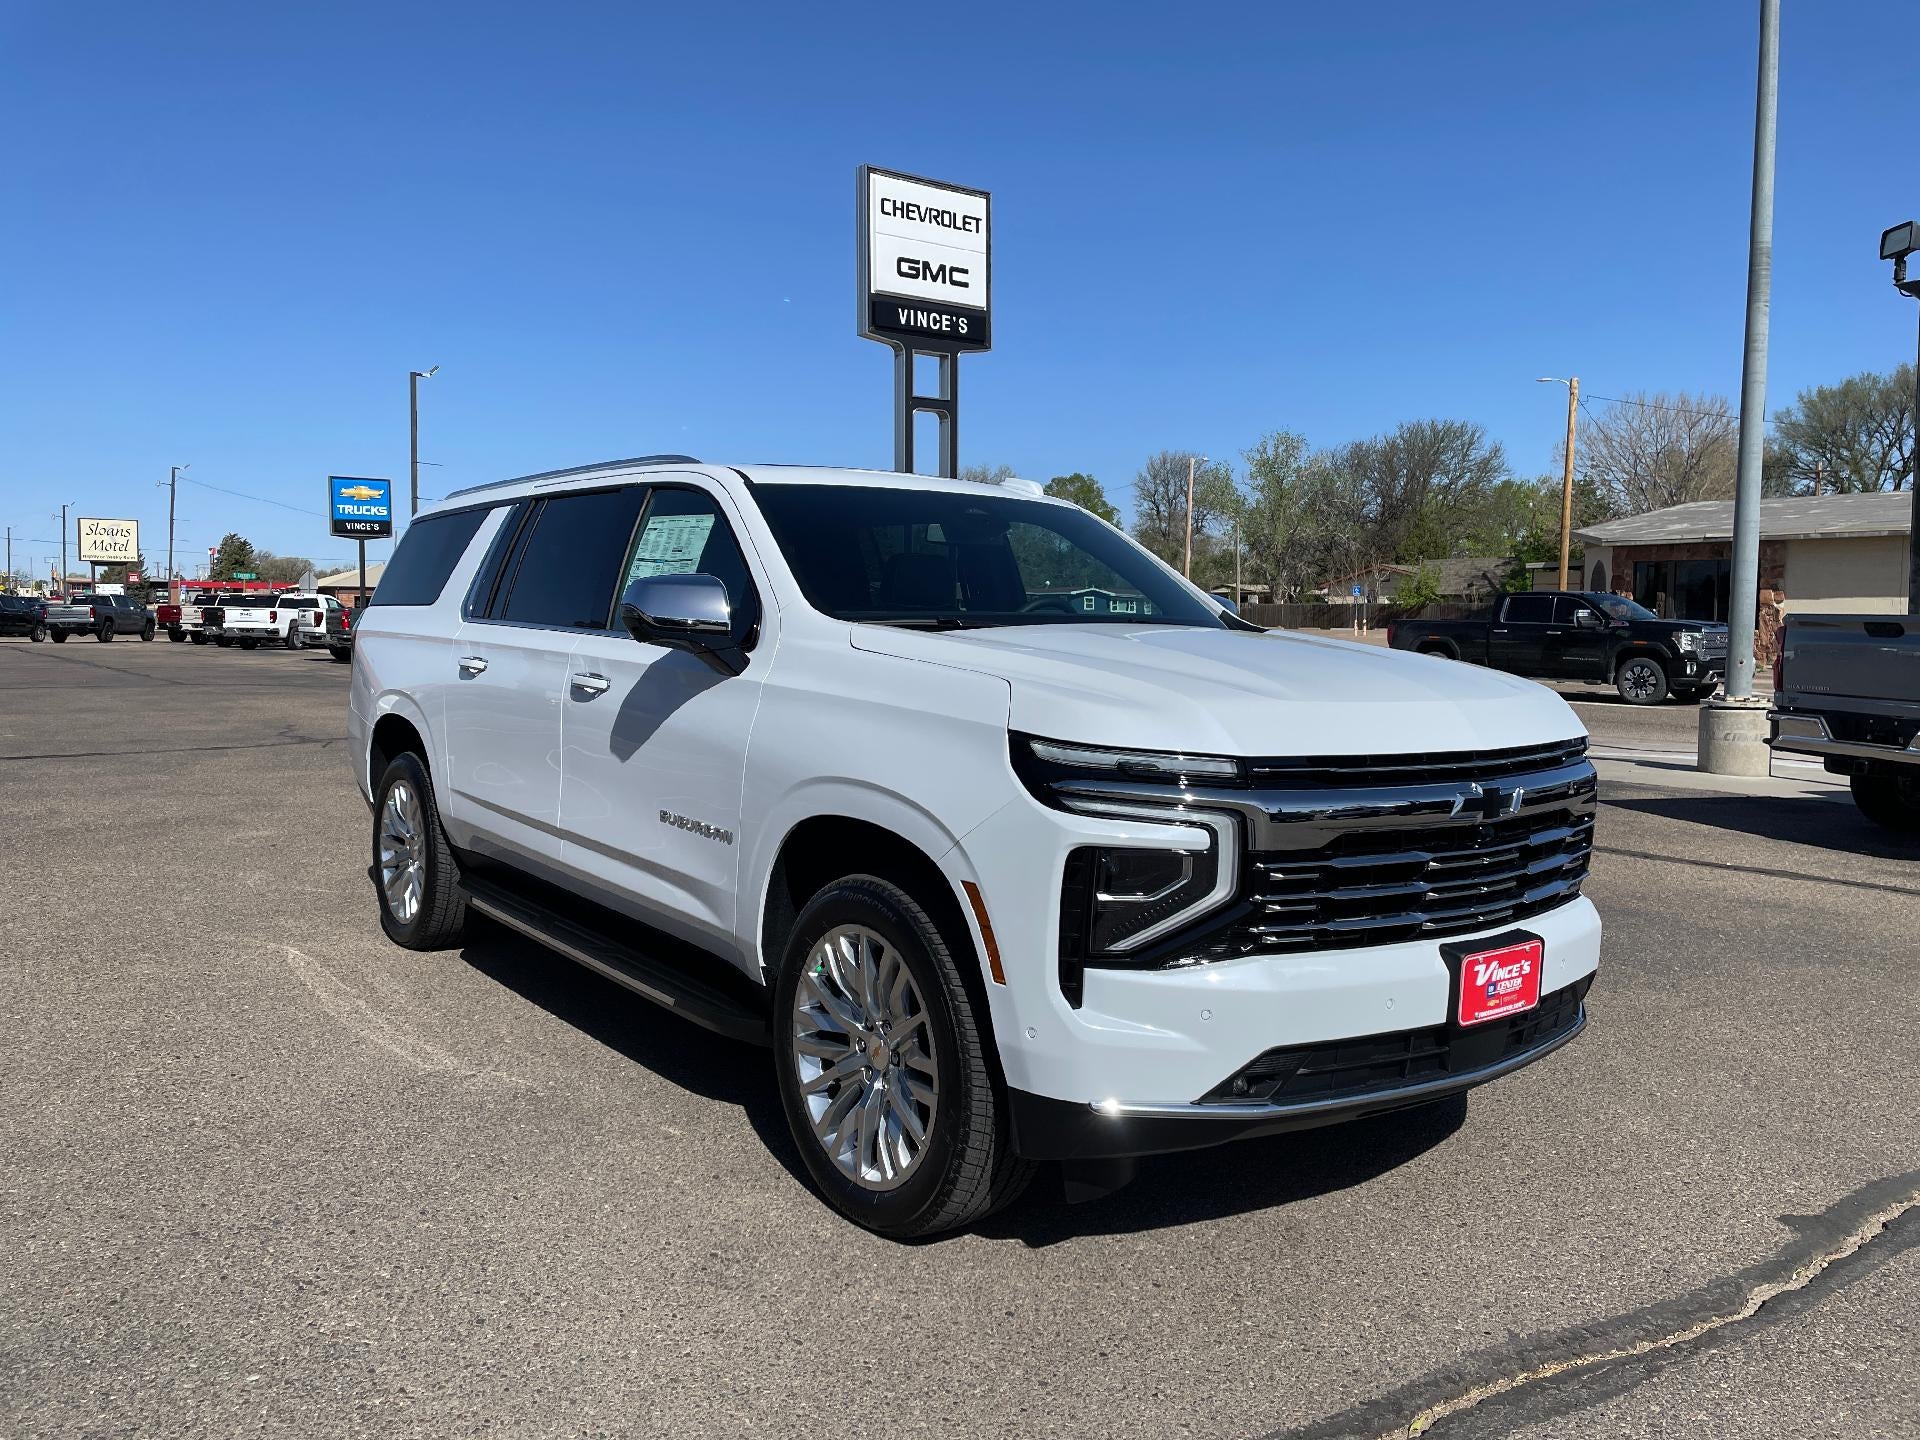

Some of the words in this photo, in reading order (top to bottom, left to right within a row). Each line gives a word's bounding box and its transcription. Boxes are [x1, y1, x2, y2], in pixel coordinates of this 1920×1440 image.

[880, 198, 982, 233] CHEVROLET
[896, 256, 969, 288] GMC
[898, 307, 968, 334] VINCE'S
[336, 504, 388, 516] TRUCKS
[86, 522, 131, 537] Sloans
[345, 522, 380, 530] VINCE'S
[89, 539, 129, 551] Motel
[659, 809, 733, 845] SUBURBAN
